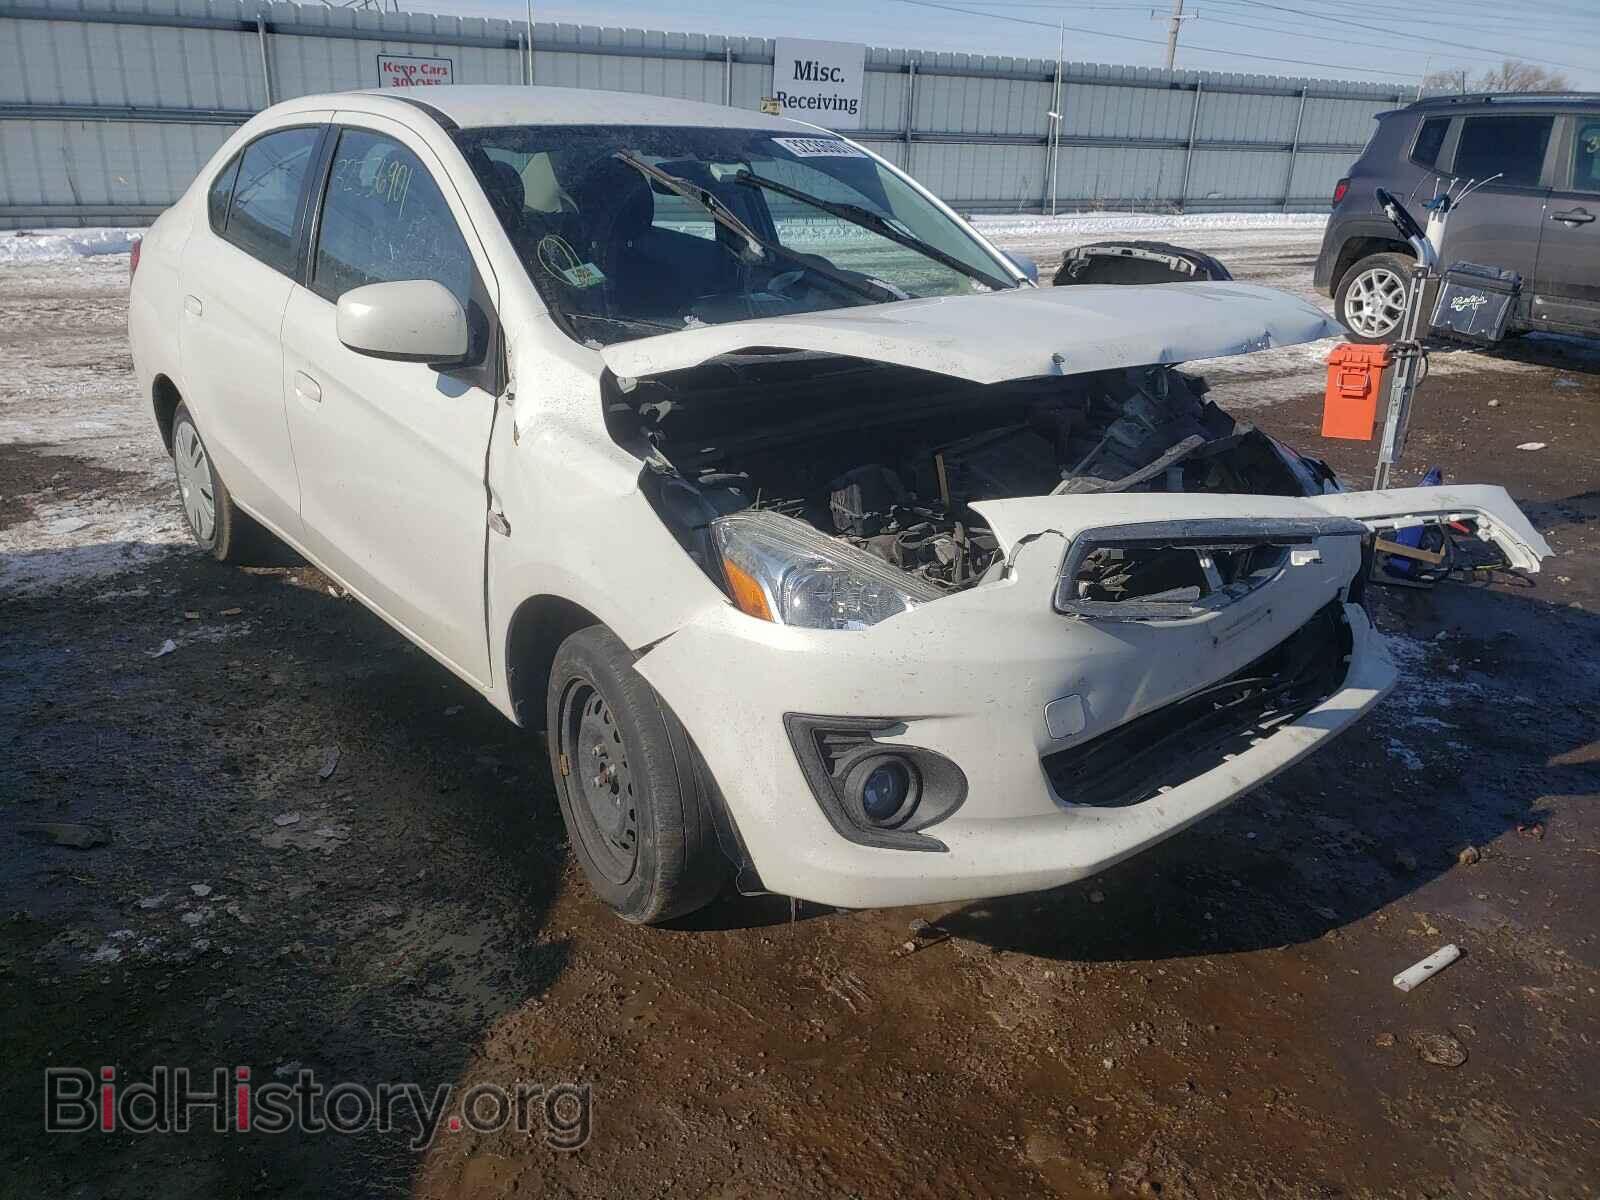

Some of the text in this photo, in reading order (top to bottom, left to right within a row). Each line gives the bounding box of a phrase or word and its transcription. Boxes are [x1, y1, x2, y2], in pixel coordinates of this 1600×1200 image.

[383, 62, 448, 76] Keep Cars
[793, 60, 845, 83] Misc.
[776, 91, 858, 114] Receiving
